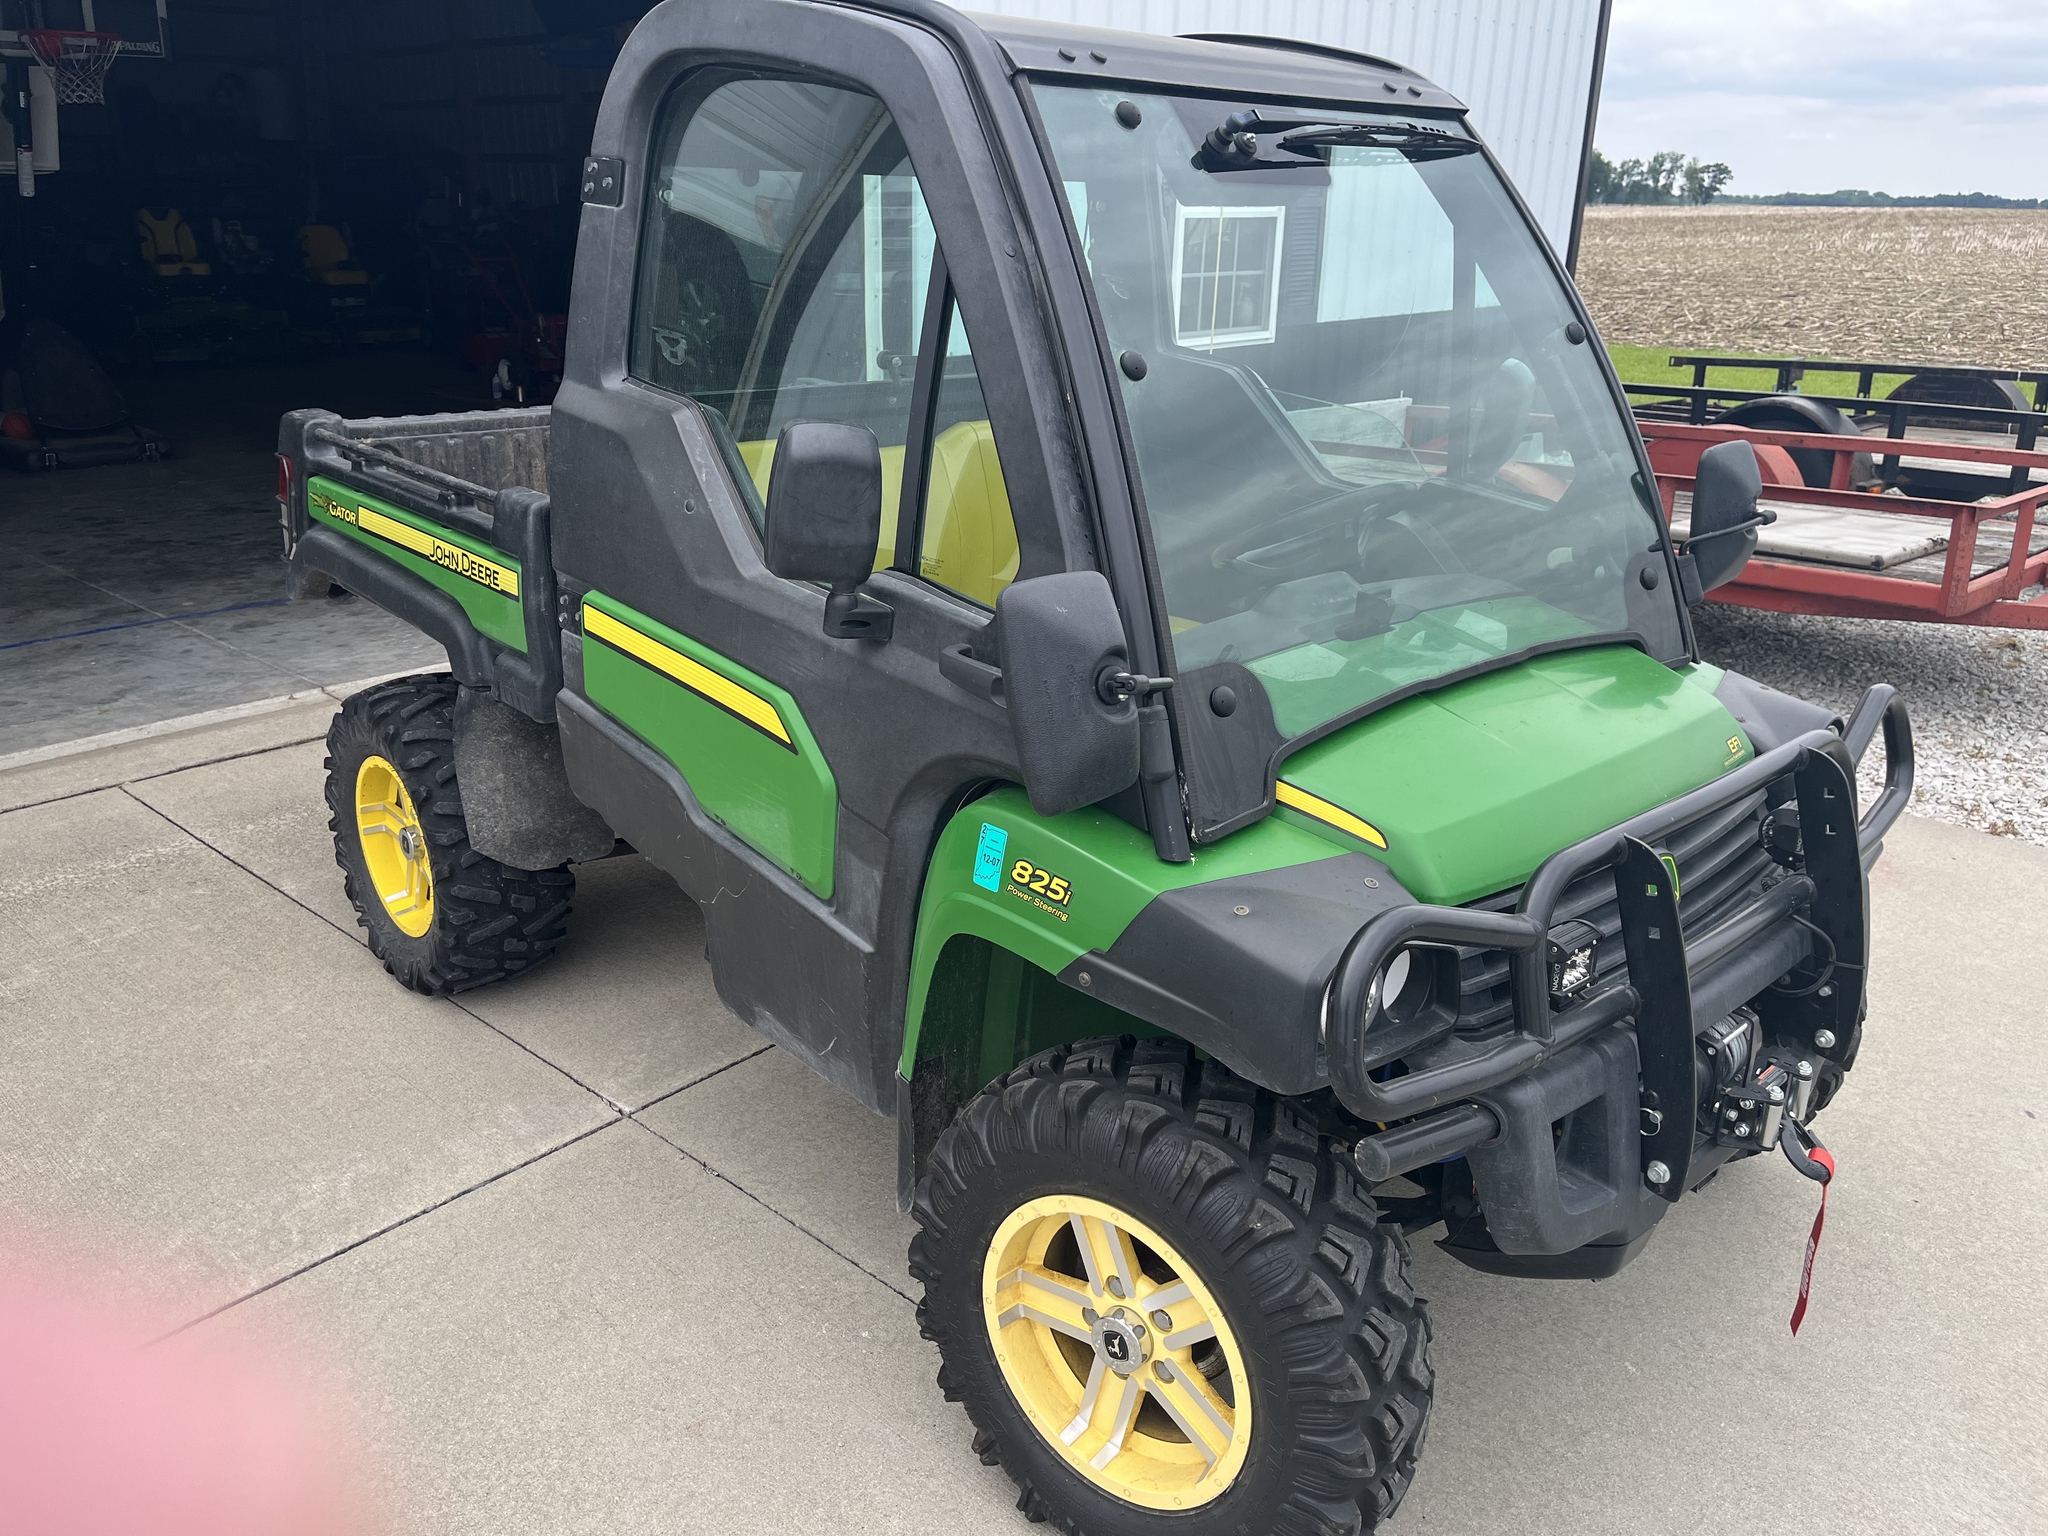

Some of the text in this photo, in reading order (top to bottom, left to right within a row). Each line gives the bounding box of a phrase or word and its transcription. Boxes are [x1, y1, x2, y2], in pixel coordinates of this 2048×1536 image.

[329, 502, 357, 525] GATOR
[429, 540, 501, 588] JOHN DEERE
[1726, 735, 1743, 754] EFI
[983, 853, 1001, 867] 12-07
[1011, 860, 1073, 907] 825i
[1006, 884, 1069, 922] Power Steering
